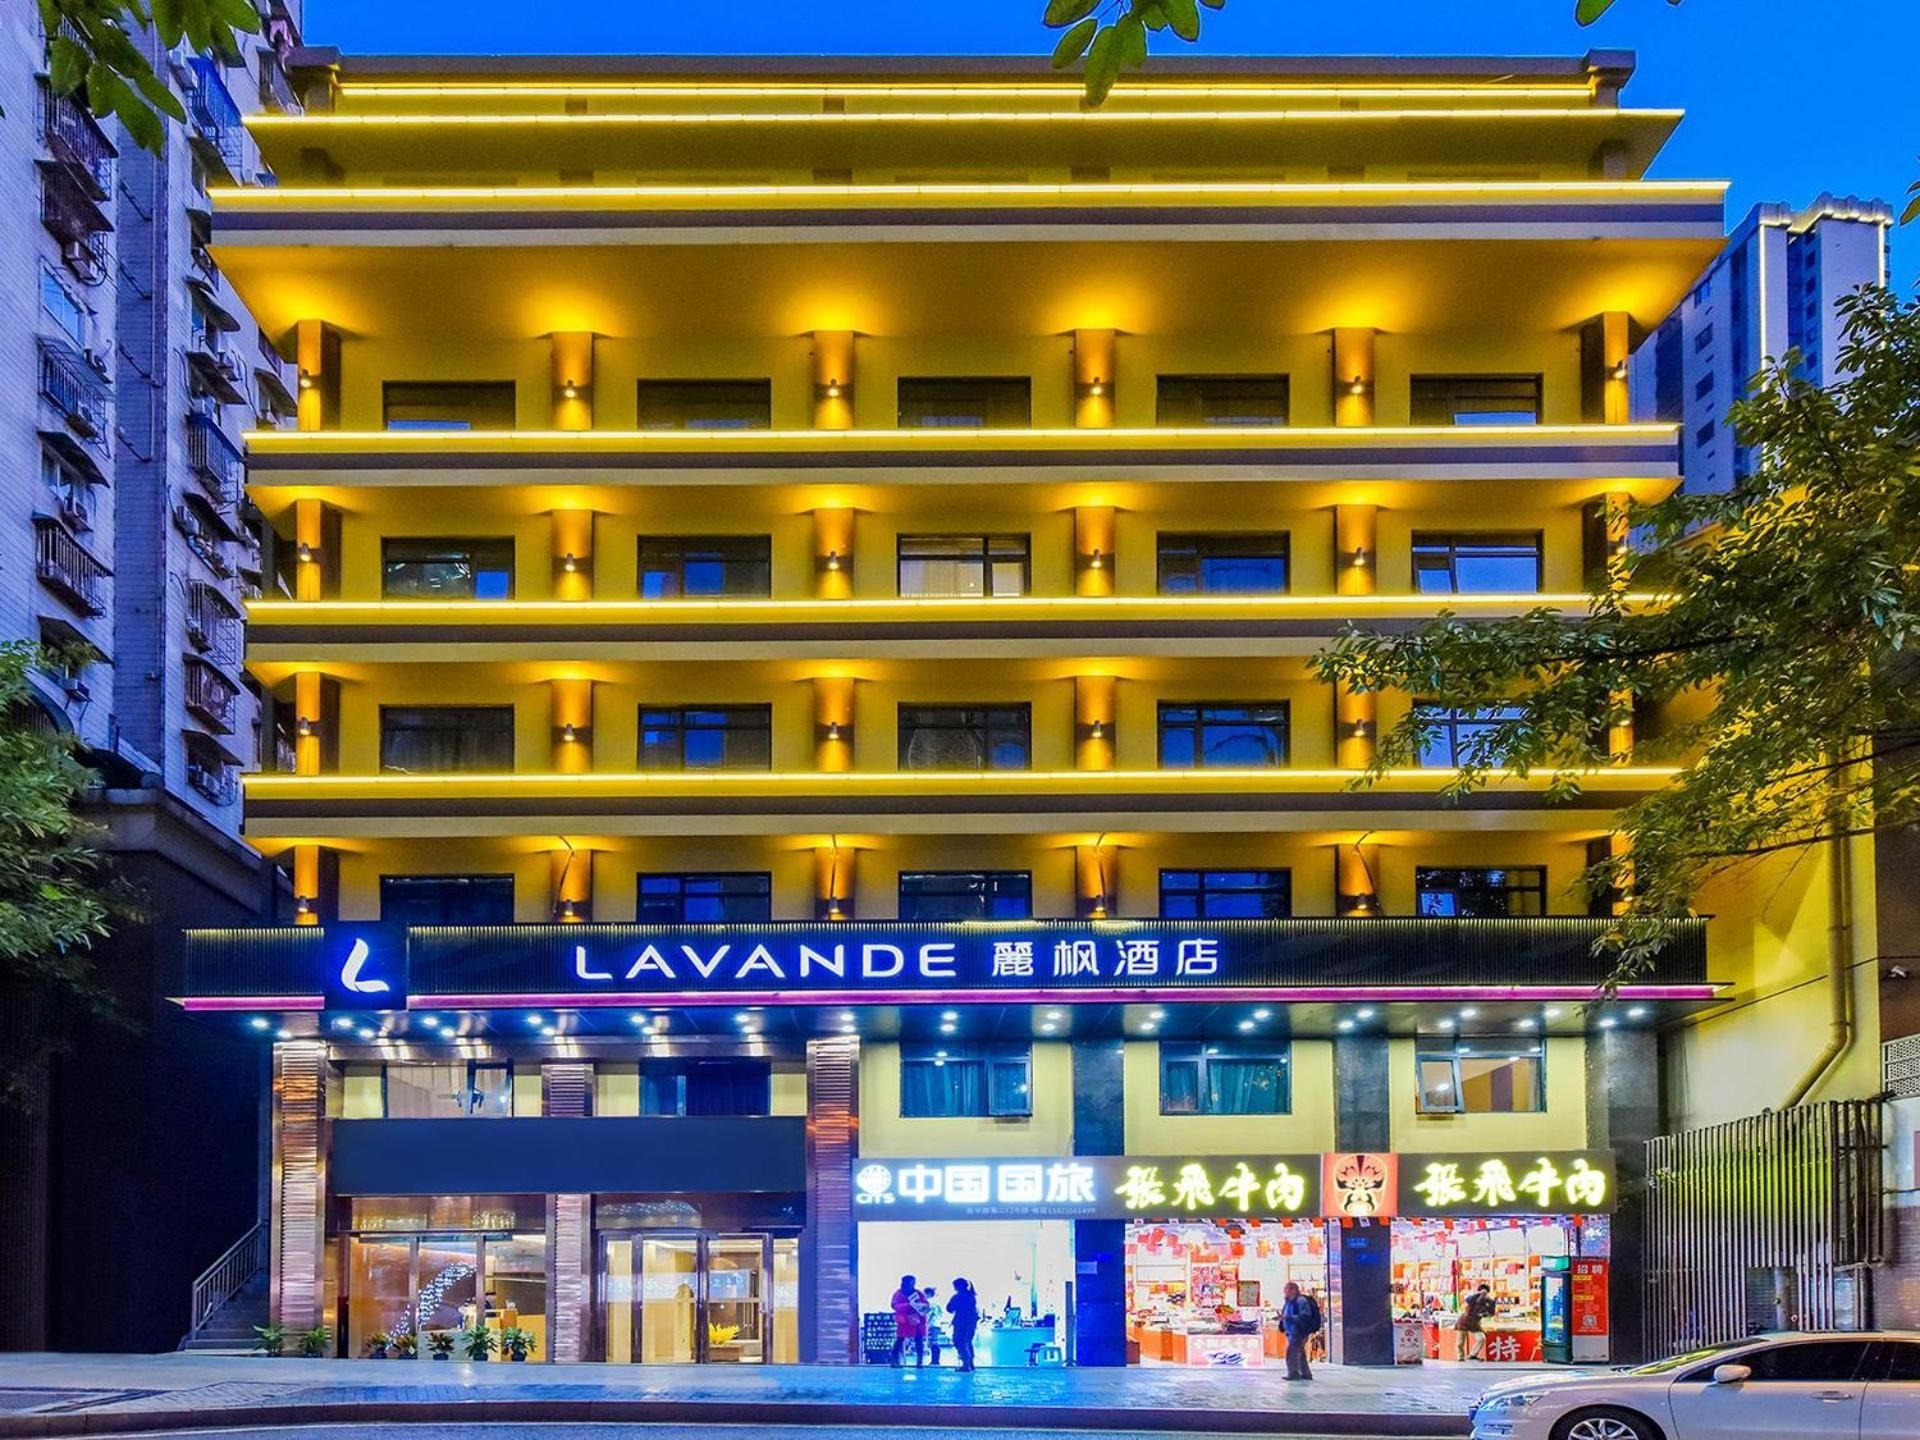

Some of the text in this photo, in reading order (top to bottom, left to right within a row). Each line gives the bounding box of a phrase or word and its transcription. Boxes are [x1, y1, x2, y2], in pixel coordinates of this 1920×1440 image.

[575, 943, 957, 980] LAVANDE
[898, 1162, 1096, 1204] 中国国旅
